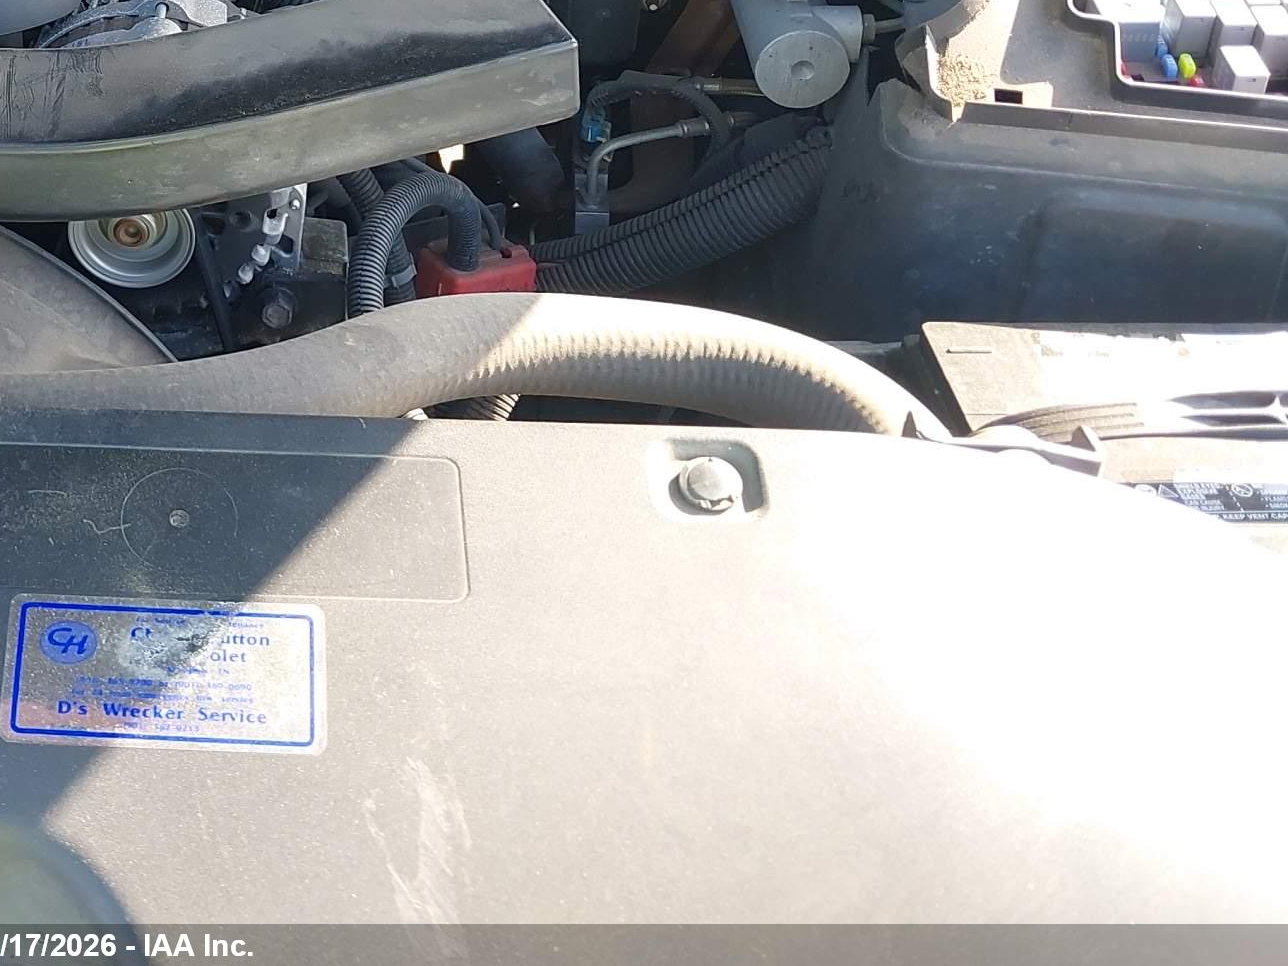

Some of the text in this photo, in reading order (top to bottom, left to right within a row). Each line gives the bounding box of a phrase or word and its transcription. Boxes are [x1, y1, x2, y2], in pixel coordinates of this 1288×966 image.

[221, 633, 270, 647] utton
[57, 700, 267, 724] D's Wrecker Service
